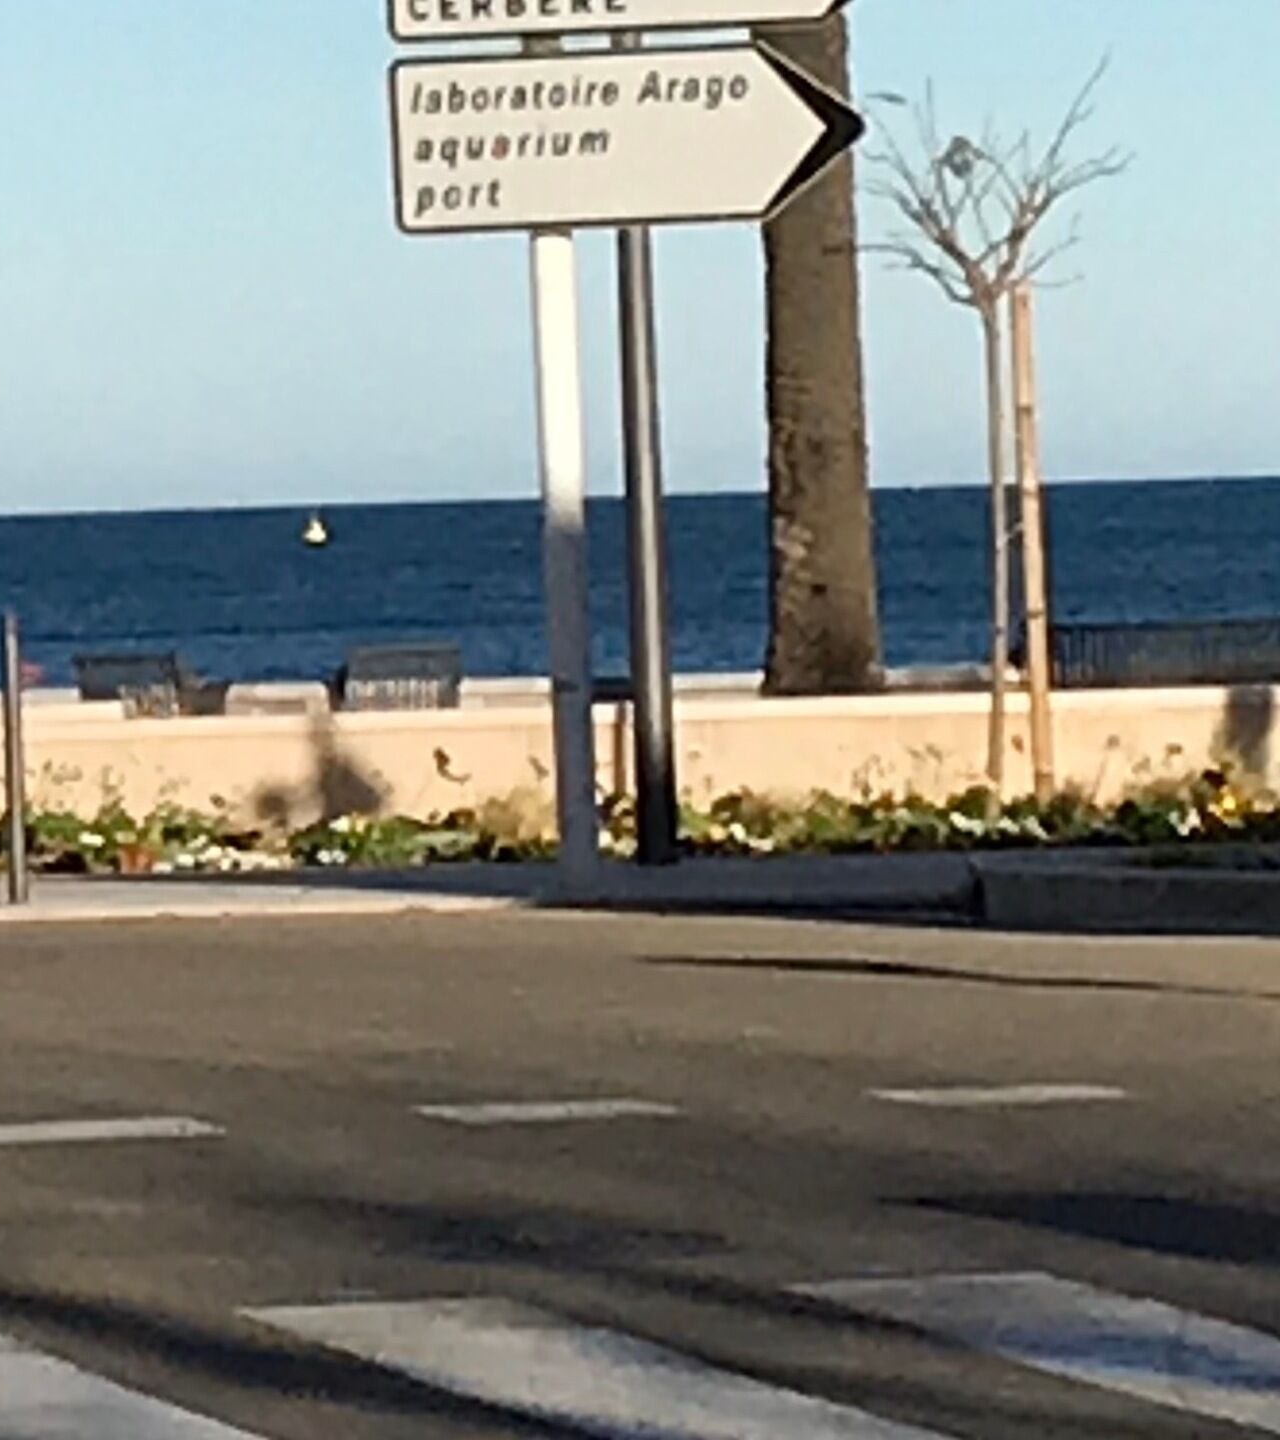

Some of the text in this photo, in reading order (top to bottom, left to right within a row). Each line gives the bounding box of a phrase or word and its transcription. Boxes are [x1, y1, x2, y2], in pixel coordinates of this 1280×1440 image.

[408, 70, 751, 116] laboratoire Arago
[413, 125, 610, 169] aquarium
[414, 178, 502, 218] port
